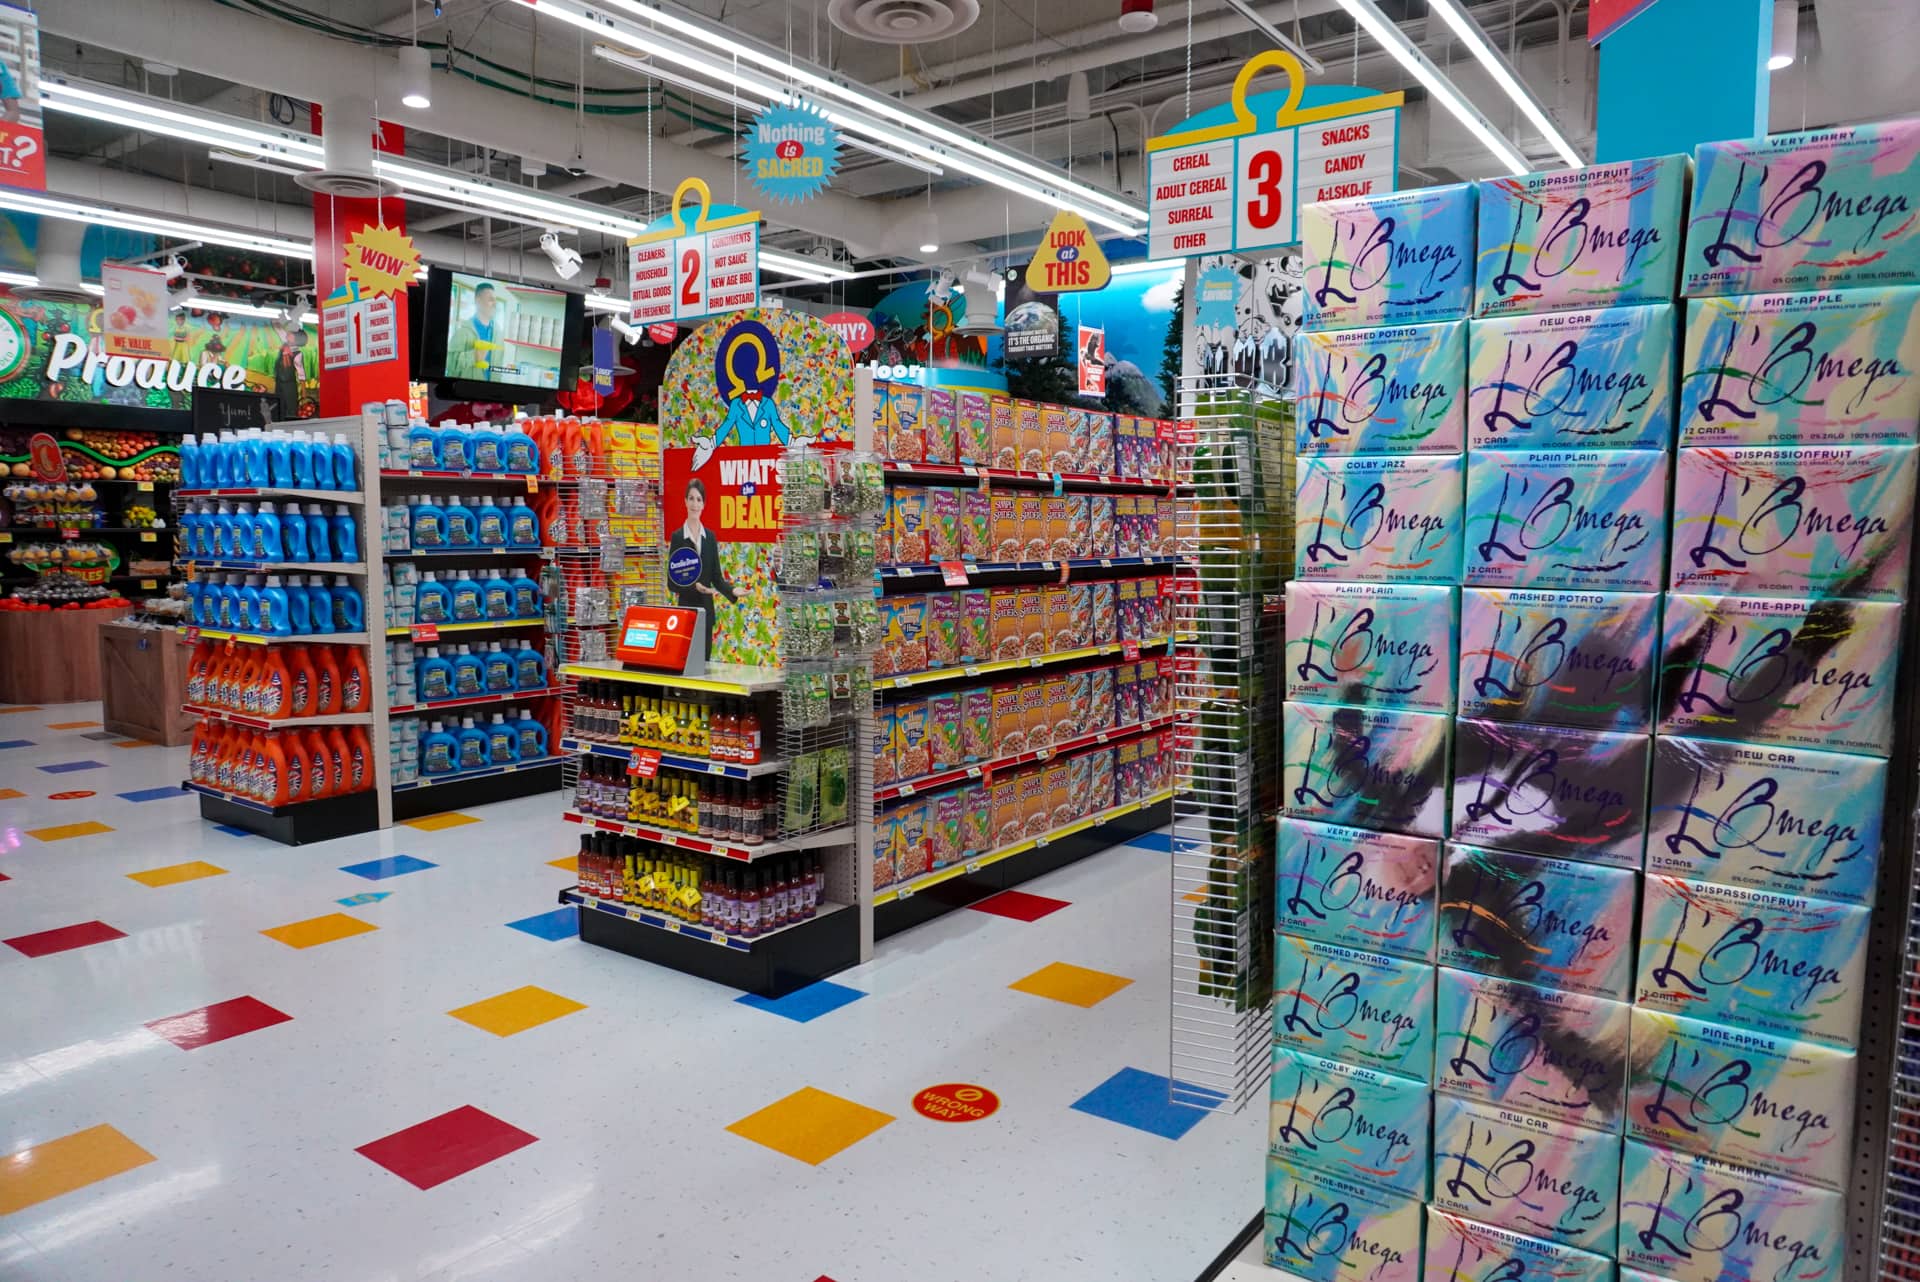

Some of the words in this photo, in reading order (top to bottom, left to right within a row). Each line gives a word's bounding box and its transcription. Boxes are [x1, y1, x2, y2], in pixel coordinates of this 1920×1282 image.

[759, 123, 826, 146] Nothing
[1322, 124, 1370, 146] SNACKS
[1771, 136, 1806, 147] VERY
[1811, 132, 1856, 143] BARRY
[784, 141, 797, 157] is
[757, 157, 823, 178] SACRED
[1173, 153, 1211, 172] CEREAL
[1325, 154, 1366, 174] CANDY
[1529, 167, 1630, 188] DISPASSIONFRUIT
[1156, 184, 1186, 201] ADULT
[1189, 177, 1227, 195] CEREAL
[1248, 150, 1282, 229] 3
[1168, 206, 1214, 225] SURREAL
[712, 232, 751, 248] CONDIMENTS
[1050, 230, 1086, 248] LOOK
[1173, 232, 1206, 250] OTHER
[638, 248, 665, 262] CLEANERS
[715, 257, 726, 268] HOT
[728, 253, 747, 266] SAUCE
[1061, 248, 1075, 260] at
[636, 267, 668, 281] HOUSEHOLD
[681, 249, 700, 305] 2
[711, 277, 725, 288] NEW
[726, 274, 738, 286] AGE
[739, 272, 752, 284] BBQ
[1044, 260, 1090, 287] THIS
[1701, 272, 1730, 280] CANS
[633, 289, 651, 300] RITUAL
[653, 286, 671, 298] GOODS
[709, 297, 724, 309] BIRD
[726, 293, 754, 306] MUSTARD
[1763, 294, 1843, 307] PINE-APPLE
[634, 309, 642, 319] AIR
[643, 304, 671, 318] FRESHENERS
[1540, 317, 1564, 326] NEW
[1569, 315, 1592, 324] CAR
[354, 311, 361, 354] 1
[1020, 336, 1030, 345] THE
[1030, 334, 1055, 344] ORGANIC
[1336, 333, 1375, 342] MASHED
[1379, 329, 1417, 339] POTATO
[129, 337, 152, 350] VALUE
[1684, 427, 1694, 435] 12
[1529, 454, 1561, 462] PLAIN
[1565, 454, 1598, 462] PLAIN
[1734, 450, 1853, 460] DISPASSIONFRUIT
[720, 459, 785, 486] WHAT'S
[1346, 461, 1377, 469] COLBY
[1381, 460, 1405, 469] JAZZ
[1478, 566, 1502, 574] CANS
[1336, 586, 1363, 594] PLAIN
[1366, 586, 1394, 594] PLAIN
[1509, 593, 1555, 602] MASHED
[1559, 594, 1604, 603] POTATO
[1735, 750, 1764, 760] NEW
[1768, 753, 1795, 763] CAR
[1327, 827, 1350, 836] VERY
[1543, 861, 1570, 871] JAZZ
[1652, 855, 1663, 863] 12
[1665, 857, 1692, 868] CANS
[1696, 884, 1808, 909] DISPASSIONFRUIT
[1313, 944, 1351, 958] MASHED
[1353, 952, 1390, 965] POTATO
[1702, 1027, 1775, 1050] PINE-APPLE
[1320, 1060, 1349, 1074] COLBY
[1352, 1068, 1376, 1080] JAZZ
[923, 1092, 985, 1117] WRONG
[924, 1103, 962, 1118] WAY
[1500, 1111, 1524, 1124] NEW
[1527, 1118, 1549, 1130] CAR
[1694, 1154, 1724, 1168] VERY
[1314, 1174, 1366, 1196] PINE-APPLE
[1469, 1223, 1560, 1256] DISPASSIONFRUIT
